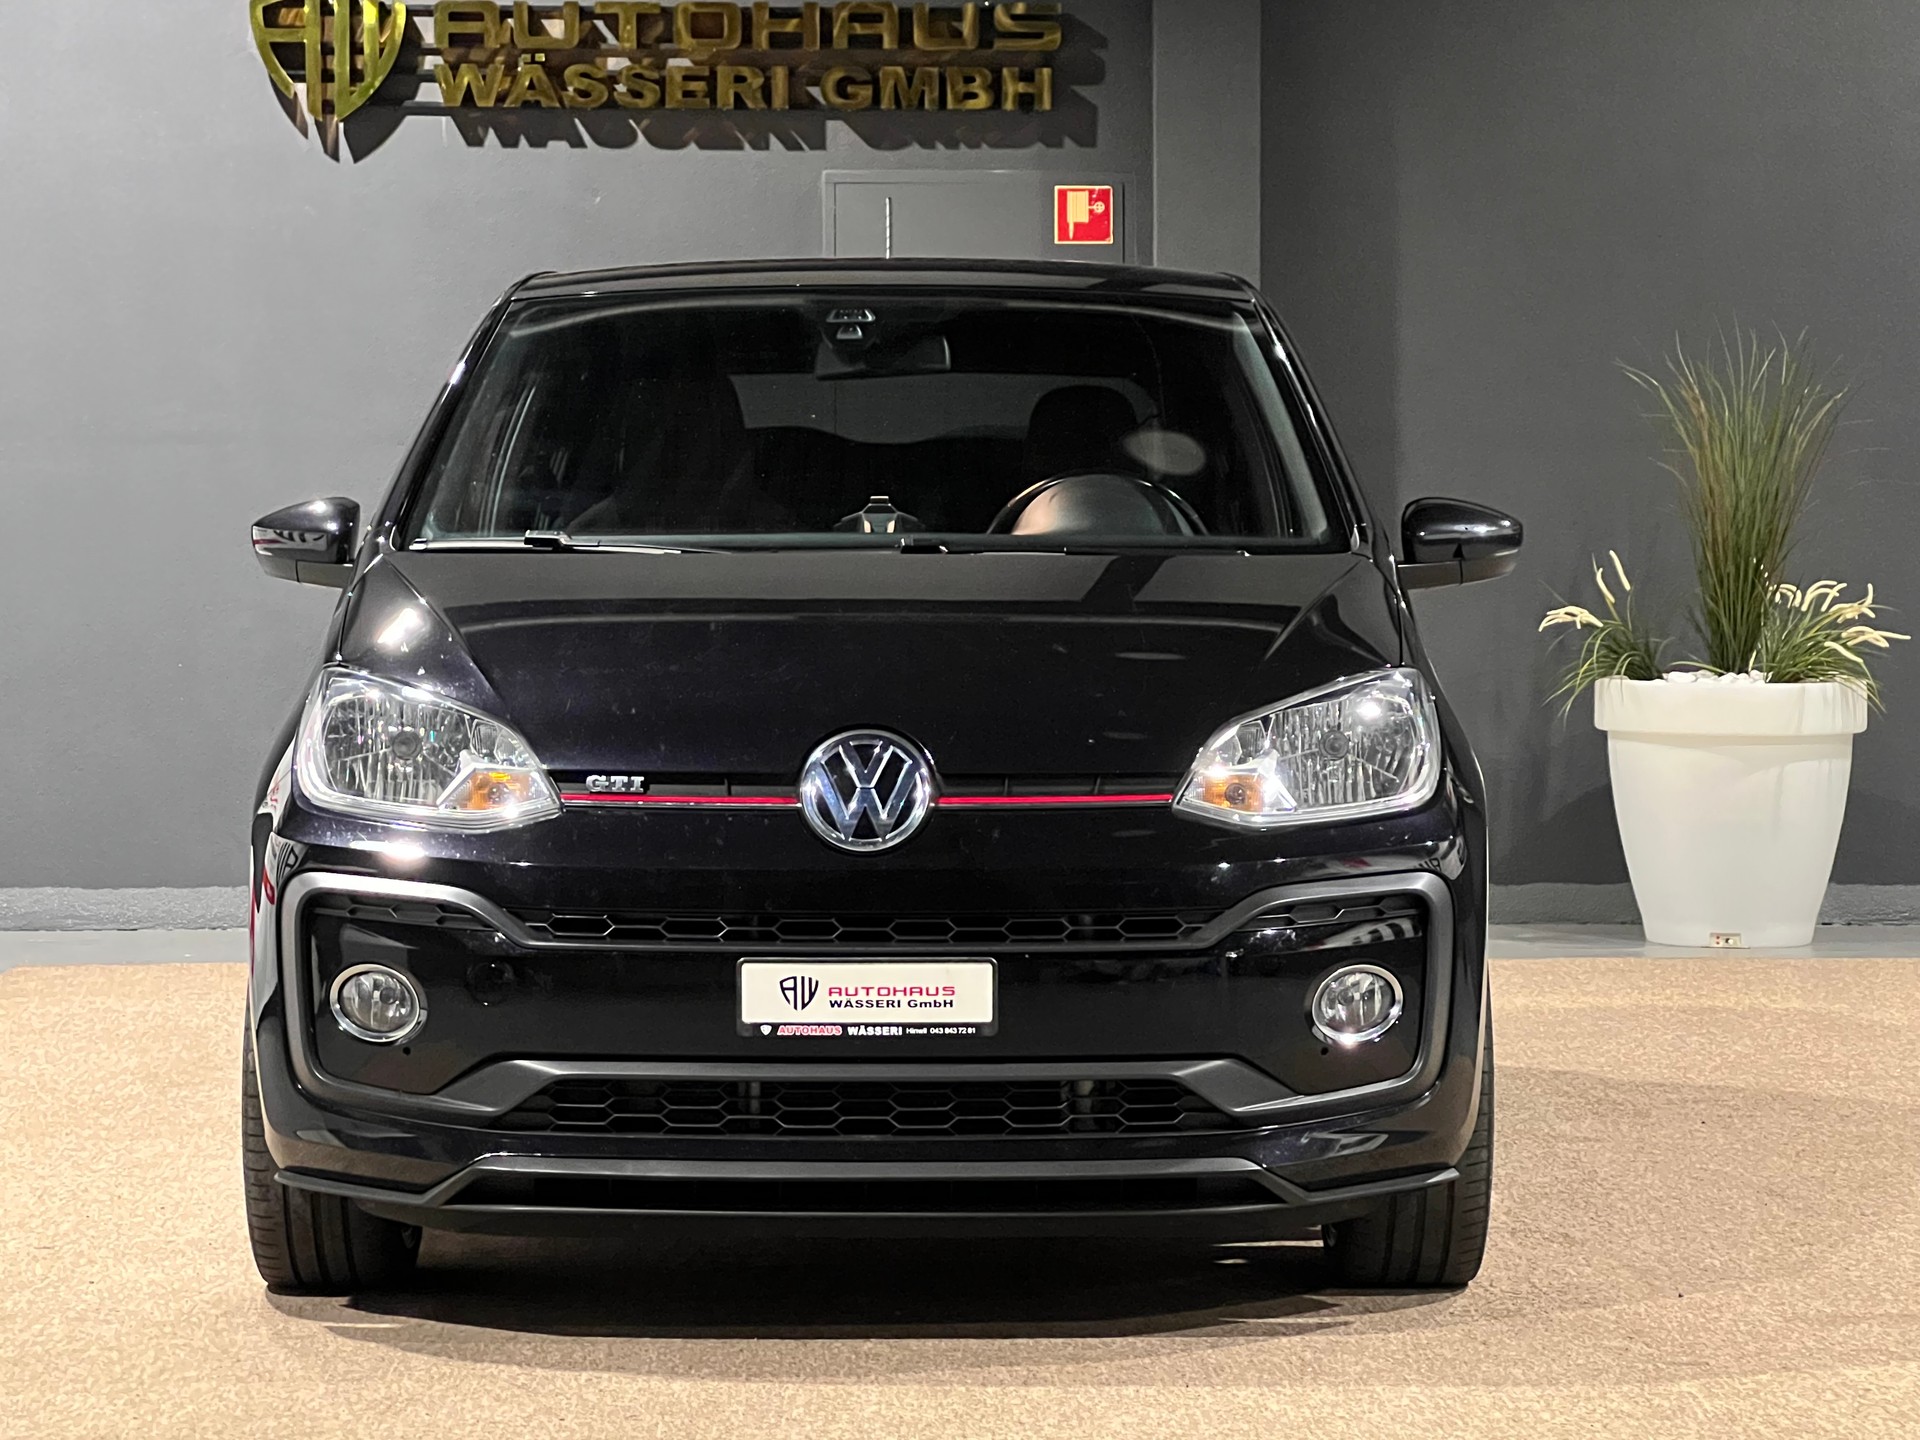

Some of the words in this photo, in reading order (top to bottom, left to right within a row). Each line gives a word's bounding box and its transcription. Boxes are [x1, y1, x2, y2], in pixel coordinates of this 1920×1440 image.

[433, 0, 1062, 50] AUTOHAUS
[434, 53, 790, 110] WÄSSERI
[820, 66, 1053, 110] GMBH
[585, 775, 646, 793] GTI
[828, 986, 956, 997] AUTOHAUS
[829, 998, 901, 1008] WÄSSERI
[907, 999, 954, 1008] GmbH
[777, 1025, 843, 1036] AUTOHAUS
[847, 1025, 903, 1036] WÄSSERI
